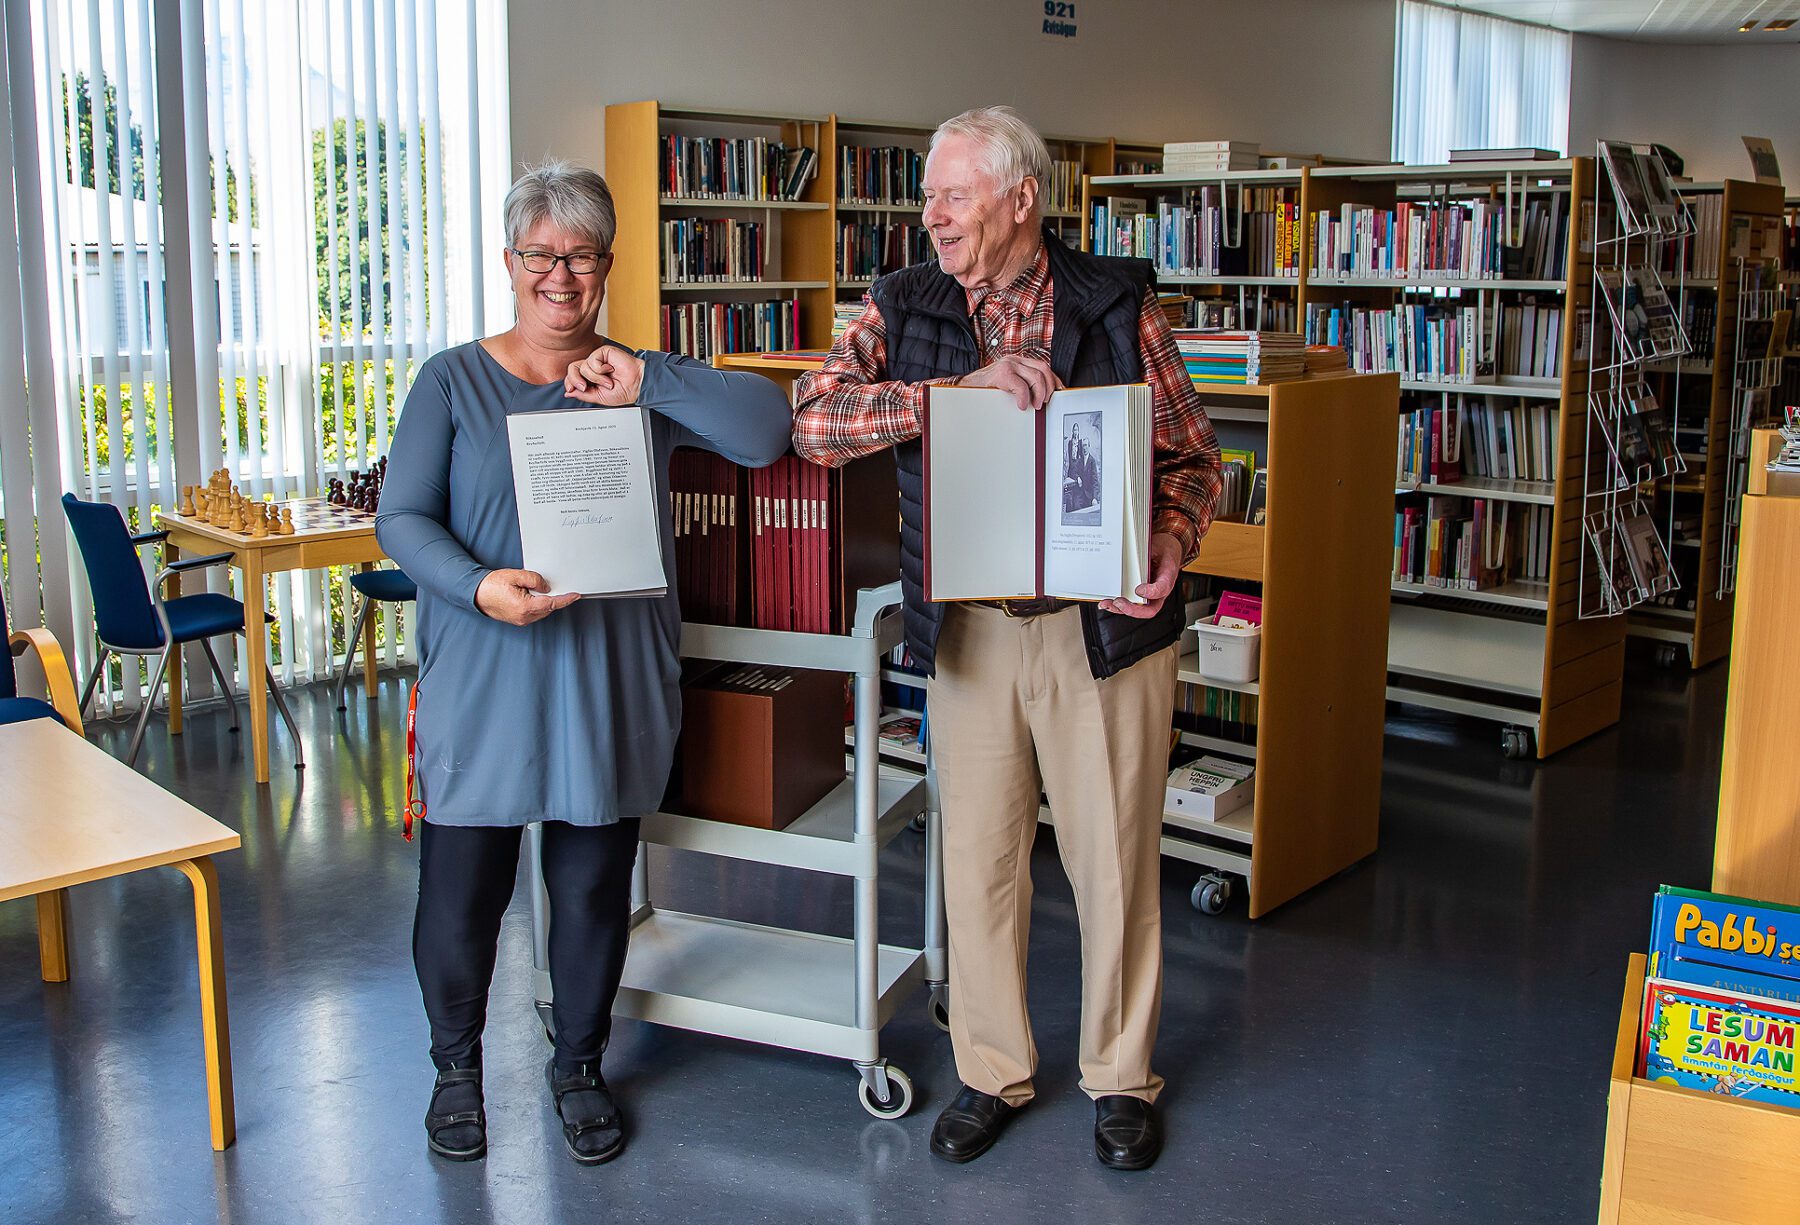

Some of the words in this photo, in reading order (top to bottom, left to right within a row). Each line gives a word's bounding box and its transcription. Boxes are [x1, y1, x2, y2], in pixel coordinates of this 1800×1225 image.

[1044, 0, 1075, 19] 921
[1188, 776, 1220, 788] HEPPIN
[1674, 903, 1778, 958] Pabbi
[1689, 1008, 1795, 1049] LESUM
[1686, 1034, 1794, 1073] SAMAN
